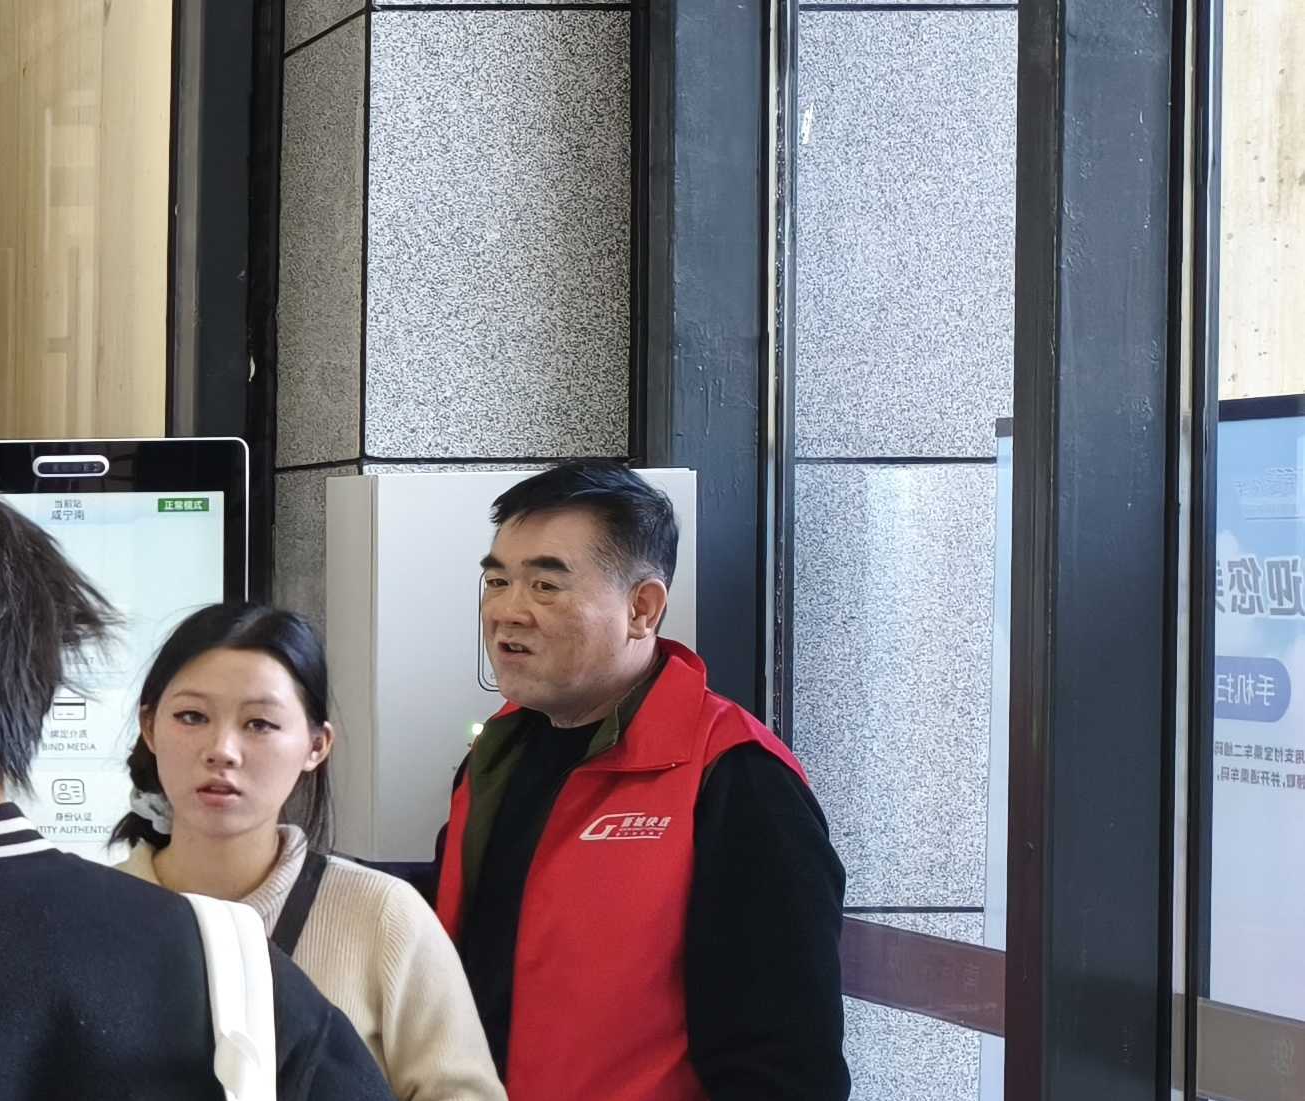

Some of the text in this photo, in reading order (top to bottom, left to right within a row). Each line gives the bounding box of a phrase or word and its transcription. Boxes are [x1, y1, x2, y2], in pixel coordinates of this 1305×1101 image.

[54, 499, 82, 509] 当前站
[51, 509, 85, 521] 咸宁南
[66, 743, 96, 752] MEDIA
[59, 825, 112, 834] AUTHENTIC
